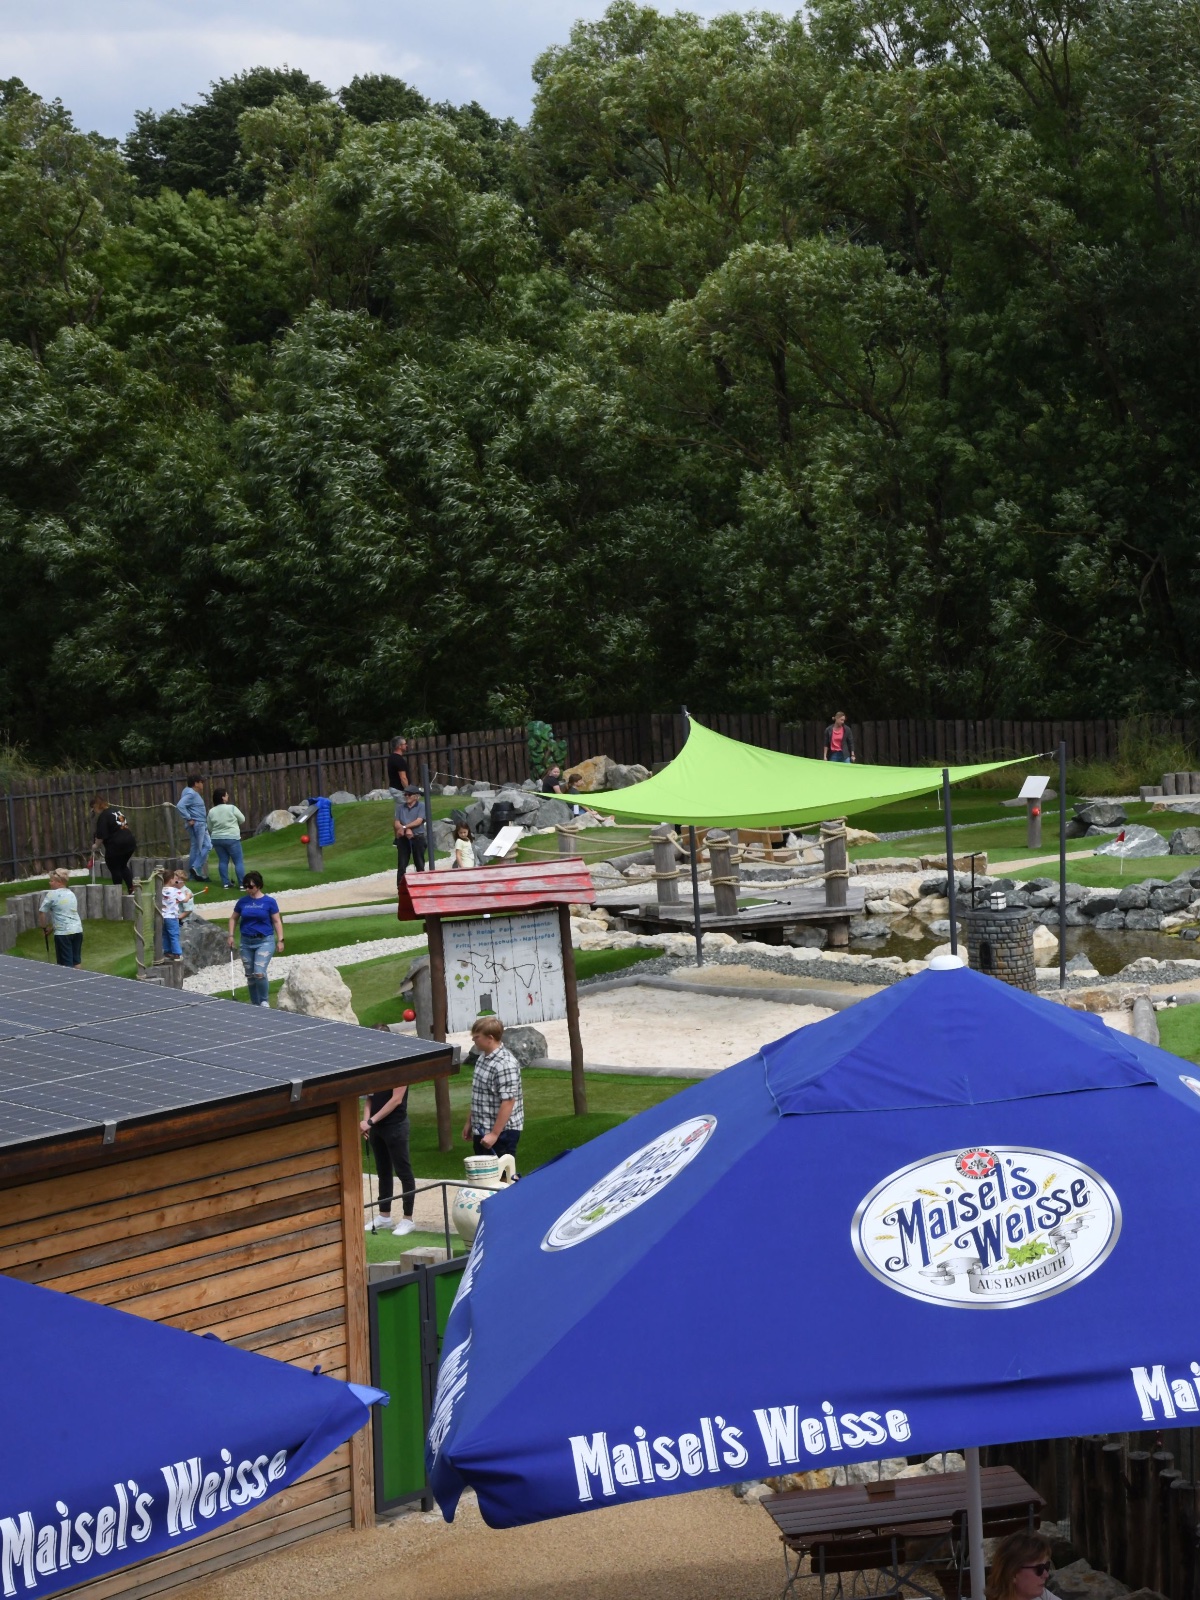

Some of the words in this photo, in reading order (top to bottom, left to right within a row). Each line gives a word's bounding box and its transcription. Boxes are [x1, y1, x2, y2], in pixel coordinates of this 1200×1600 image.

[882, 1158, 1038, 1272] Maisel's
[954, 1178, 1090, 1269] Weisse
[977, 1278, 1002, 1290] AUS
[1005, 1256, 1066, 1288] BAYREUTH
[568, 1415, 748, 1502] Maisel's
[753, 1401, 911, 1466] Weisse
[0, 1479, 154, 1597] Maisel's
[160, 1448, 287, 1536] Weisse
